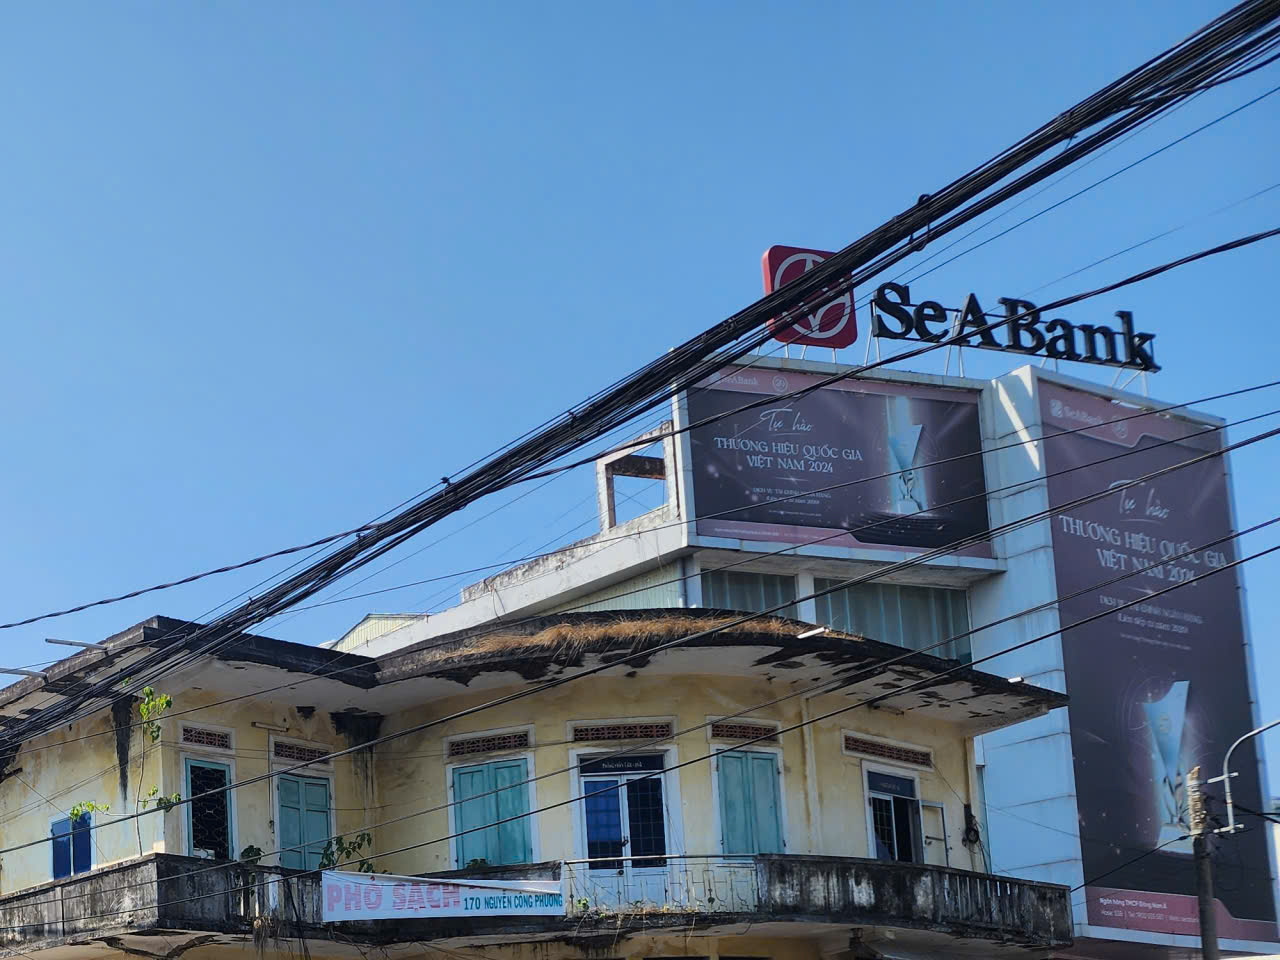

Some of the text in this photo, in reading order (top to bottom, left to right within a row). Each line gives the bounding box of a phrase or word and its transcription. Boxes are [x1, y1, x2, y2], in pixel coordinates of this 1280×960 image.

[872, 282, 1161, 373] SeABank
[714, 437, 863, 461] THƯƠNG HIỆU QUỐC GIA
[746, 455, 833, 473] VIỆT NAM 2024
[1059, 515, 1120, 545] THƯƠNG
[1125, 531, 1156, 554] HIỆU
[1205, 551, 1227, 568] GIA
[1096, 549, 1127, 571] VIỆT
[1132, 557, 1164, 580] NAM
[464, 897, 481, 911] 170
[514, 892, 533, 909] CÔNG
[535, 892, 563, 908] PHƯƠNG
